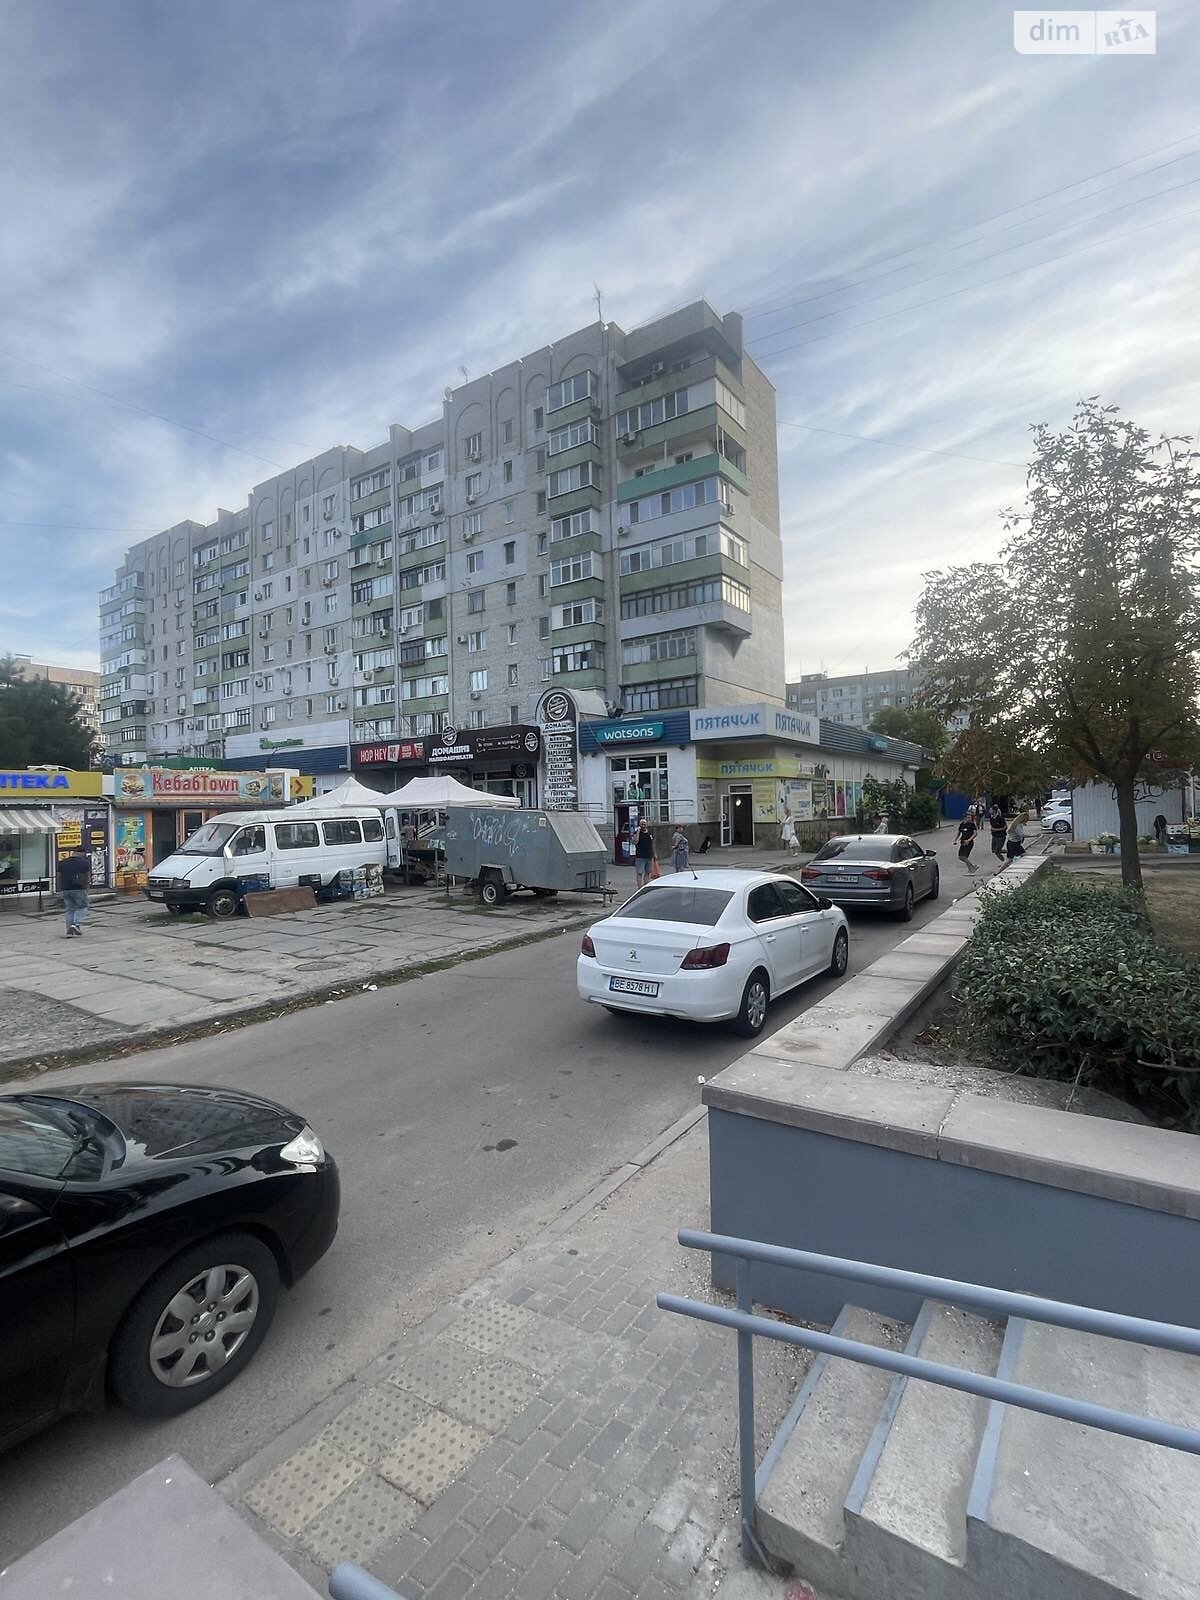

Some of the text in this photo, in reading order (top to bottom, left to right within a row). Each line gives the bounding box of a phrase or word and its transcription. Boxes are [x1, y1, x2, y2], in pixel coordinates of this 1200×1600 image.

[695, 712, 761, 731] ПЯТАЧИК
[775, 713, 811, 737] ПЯТАЧИК
[604, 726, 654, 741] watsons
[360, 746, 387, 762] HOP HEY
[721, 763, 774, 774] ПЯТАЧИК
[615, 980, 625, 989] BE
[626, 981, 643, 991] 8578
